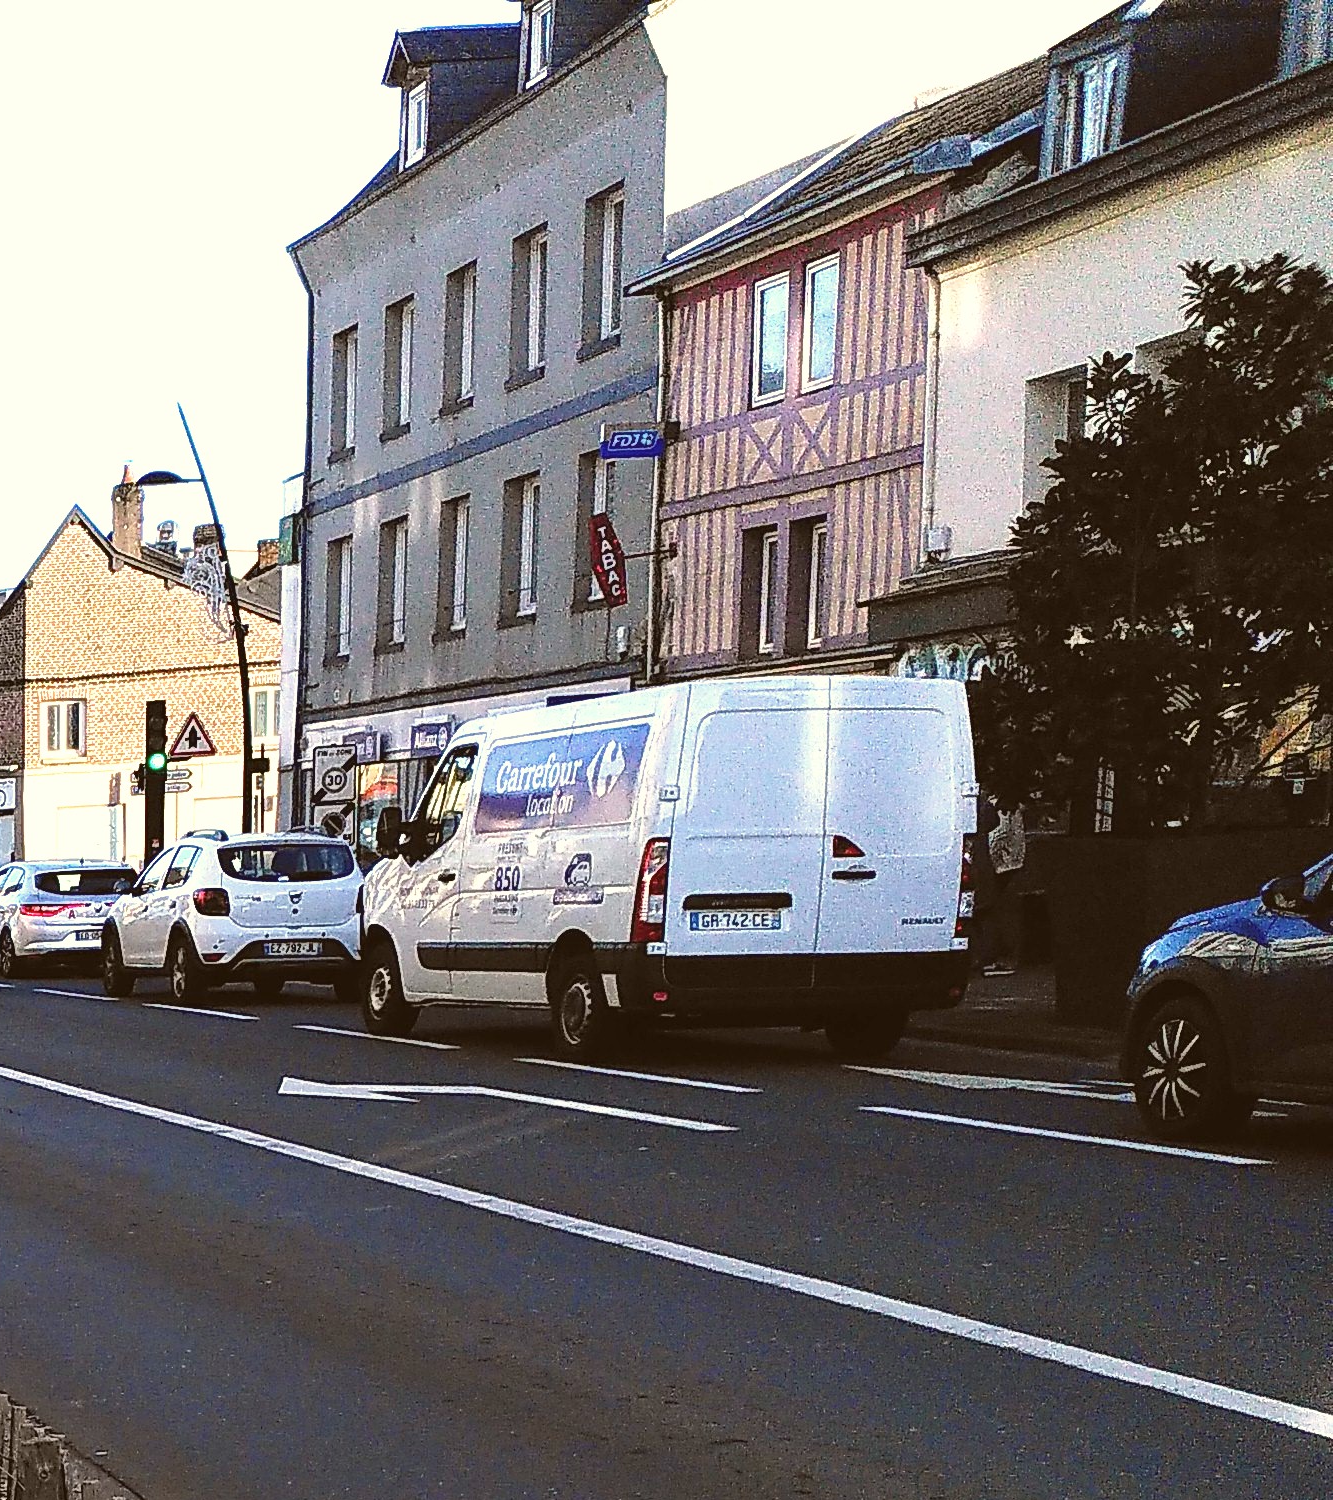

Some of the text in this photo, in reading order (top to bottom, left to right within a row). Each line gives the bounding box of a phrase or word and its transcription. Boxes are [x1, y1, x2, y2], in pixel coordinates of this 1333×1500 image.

[611, 433, 641, 447] FDJ
[597, 525, 622, 597] TABAC
[327, 774, 343, 787] 30
[496, 752, 583, 794] Carrefour
[494, 865, 521, 891] 850
[901, 916, 946, 926] RENAULT
